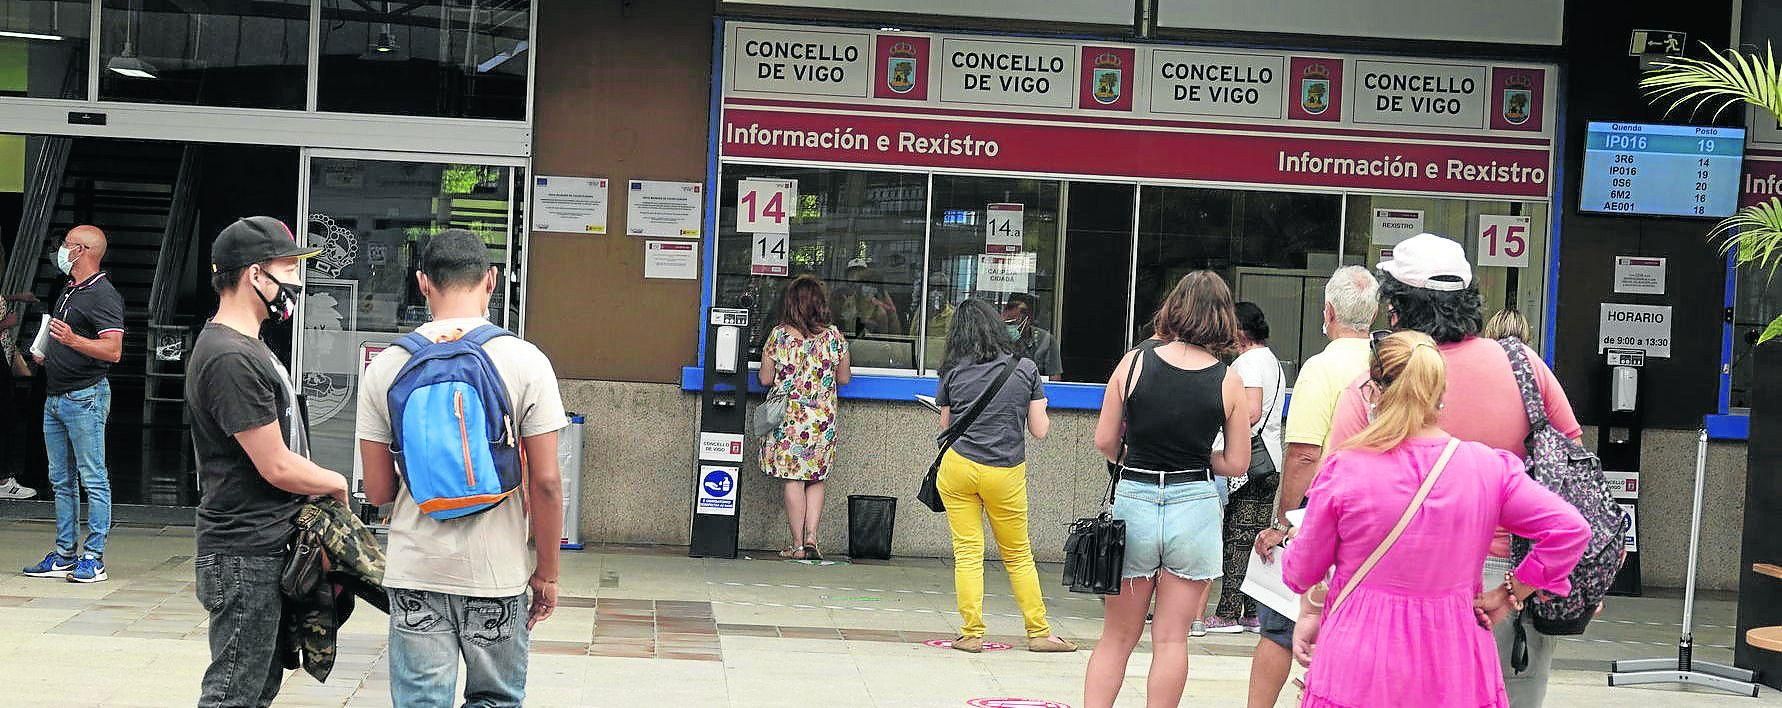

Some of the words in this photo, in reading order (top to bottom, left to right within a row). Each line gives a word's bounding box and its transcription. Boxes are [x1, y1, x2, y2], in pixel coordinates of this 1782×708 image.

[745, 40, 859, 62] CONCELLO
[951, 51, 1064, 73] CONCELLO
[758, 63, 785, 80] DE
[793, 65, 844, 82] VIGO
[1161, 62, 1273, 84] CONCELLO
[964, 74, 991, 91] DE
[999, 76, 1050, 94] VIGO
[1364, 73, 1475, 94] CONCELLO
[1174, 85, 1201, 101] DE
[1208, 87, 1259, 104] VIGO
[1376, 95, 1403, 112] DE
[1410, 97, 1461, 115] VIGO
[726, 123, 869, 150] Información
[876, 134, 890, 151] e
[898, 131, 999, 157] Rexistro
[1695, 127, 1718, 136] Posto
[1605, 135, 1648, 150] IP016
[1697, 139, 1715, 152] 19
[1278, 151, 1418, 178] Información
[1425, 162, 1439, 179] e
[1446, 159, 1545, 185] Rexistro
[1614, 154, 1634, 164] 3R6
[1698, 158, 1709, 167] 14
[1609, 166, 1637, 176] IP016
[1697, 171, 1708, 179] 19
[1610, 190, 1631, 199] 6M2
[1695, 182, 1707, 191] 20
[741, 190, 786, 224] 14
[1603, 202, 1635, 211] AE001
[1693, 206, 1704, 214] 18
[1382, 222, 1414, 230] REXISTRO
[757, 236, 786, 260] 14
[1482, 224, 1526, 257] 15
[1607, 311, 1664, 323] HORARIO
[1603, 335, 1615, 344] de
[1617, 336, 1635, 345] 9:00
[1646, 338, 1668, 347] 13:30
